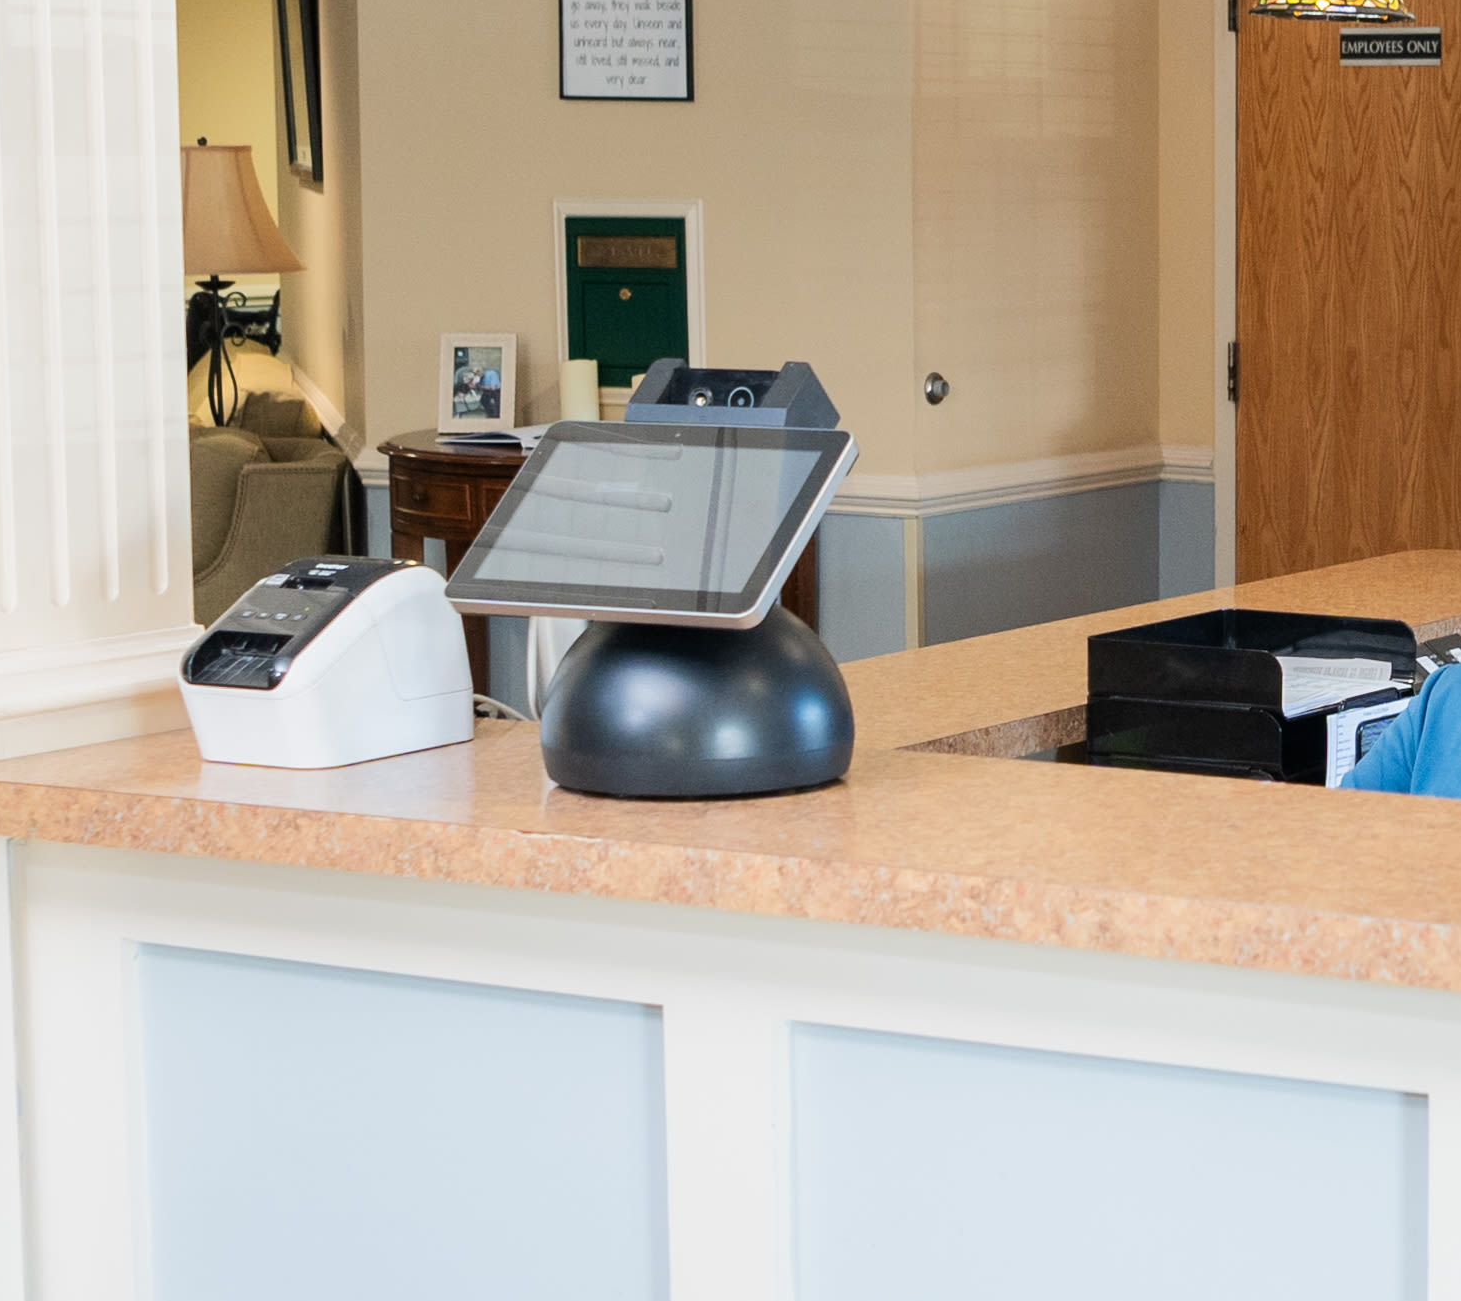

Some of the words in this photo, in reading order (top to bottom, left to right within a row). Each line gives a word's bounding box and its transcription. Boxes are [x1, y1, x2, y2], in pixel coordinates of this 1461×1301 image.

[611, 0, 630, 14] they
[656, 1, 681, 11] beside
[569, 21, 579, 29] us
[584, 21, 608, 33] every
[633, 19, 664, 29] Unseen
[667, 20, 682, 29] and
[574, 38, 607, 48] unheard
[611, 38, 624, 48] but
[627, 38, 654, 52] always
[1341, 41, 1403, 54] EMPLOYEES
[1406, 41, 1439, 54] ONLY
[665, 56, 679, 67] and
[606, 76, 625, 88] very
